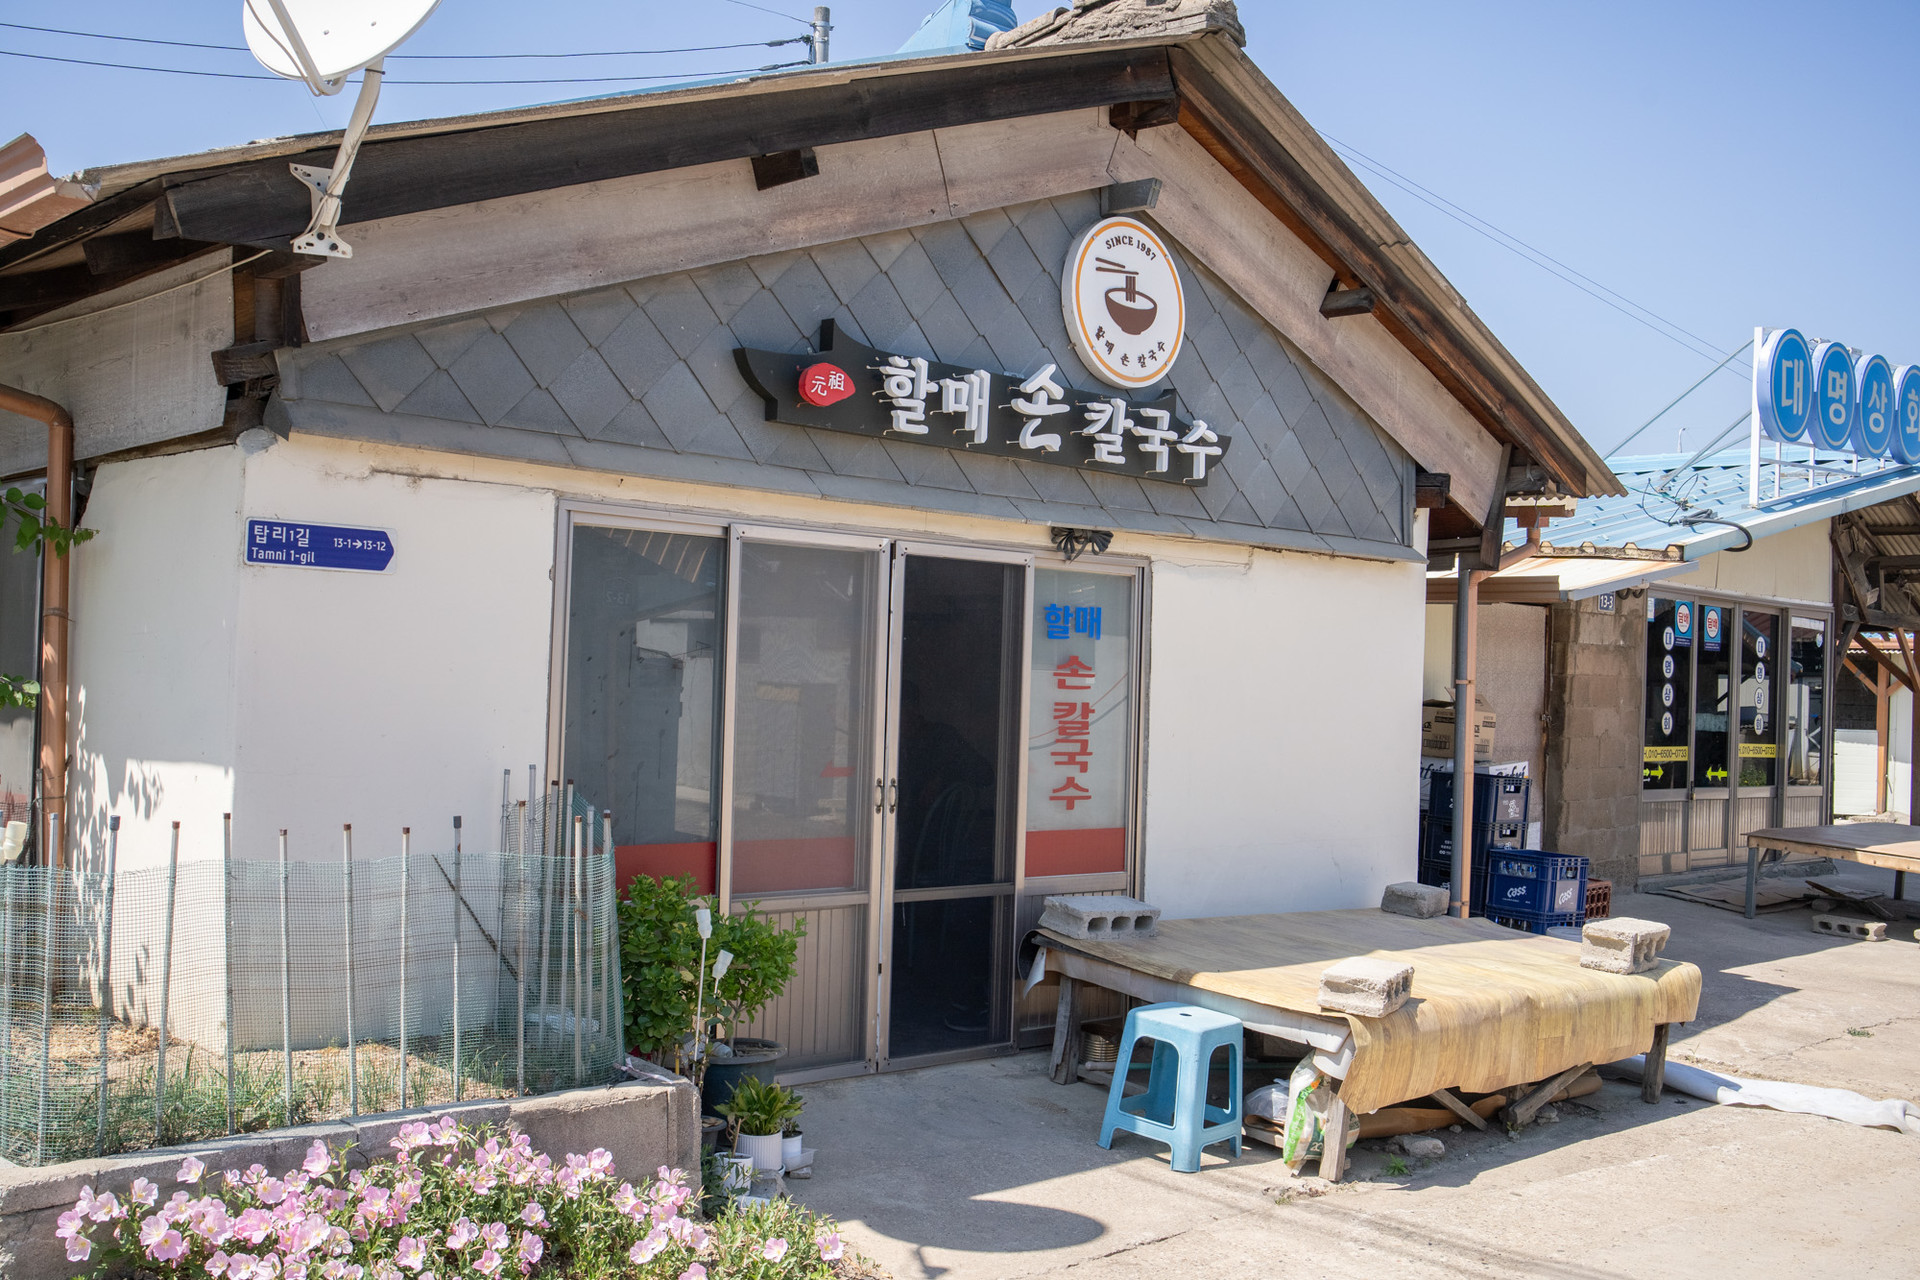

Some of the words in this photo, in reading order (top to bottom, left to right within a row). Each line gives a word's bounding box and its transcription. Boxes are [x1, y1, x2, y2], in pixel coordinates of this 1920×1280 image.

[1105, 235, 1134, 250] SINCE
[1136, 239, 1157, 261] 1987
[1137, 341, 1166, 368] 칼국수
[810, 369, 845, 397] 元祖
[882, 355, 991, 446] 할매
[1010, 363, 1071, 453] 손
[1083, 397, 1222, 481] 칼국수
[254, 524, 310, 548] 탑리1길
[251, 547, 287, 561] Tamni
[290, 550, 315, 565] 1-gil
[1600, 595, 1614, 609] 13-3
[1043, 603, 1102, 641] 할매
[1053, 655, 1096, 690] 손
[1049, 701, 1096, 811] 칼국수
